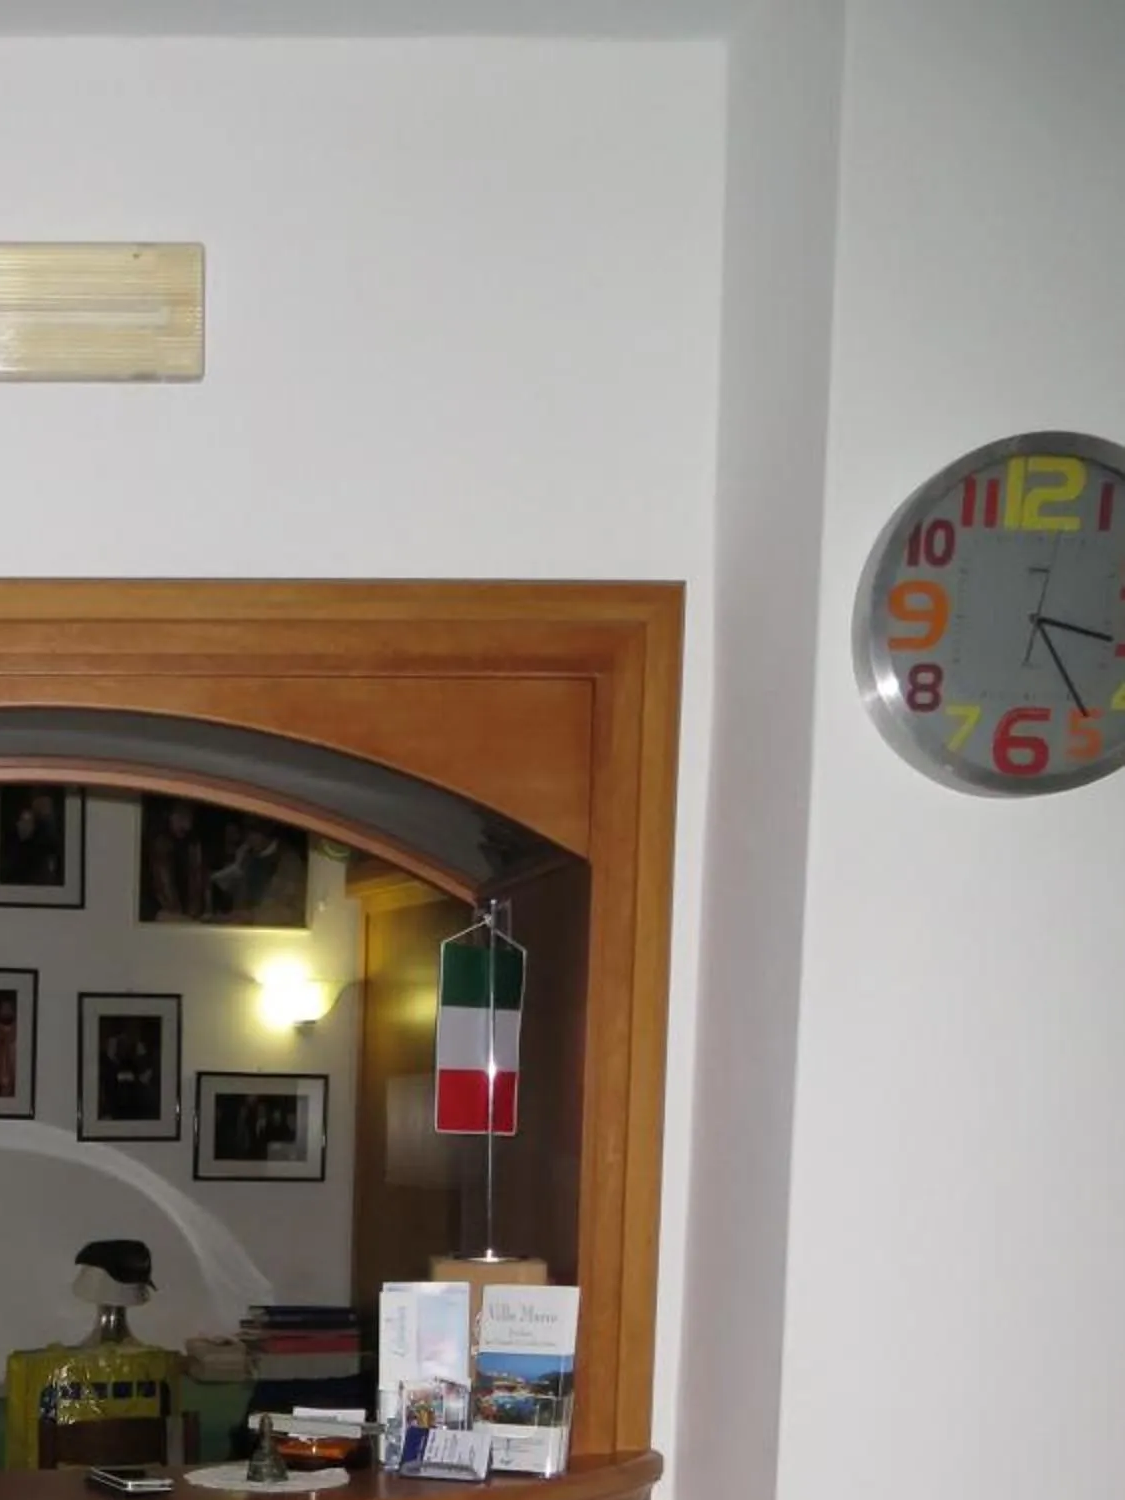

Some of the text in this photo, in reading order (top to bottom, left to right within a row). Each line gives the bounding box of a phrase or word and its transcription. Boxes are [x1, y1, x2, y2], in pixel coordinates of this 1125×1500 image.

[961, 474, 999, 529] 11
[1004, 456, 1087, 531] 12
[1097, 481, 1115, 532] 1
[906, 517, 956, 568] 10
[887, 578, 950, 653] 9
[905, 662, 944, 713] 8
[944, 704, 981, 751] 7
[992, 706, 1052, 776] 6
[1064, 708, 1104, 762] 5
